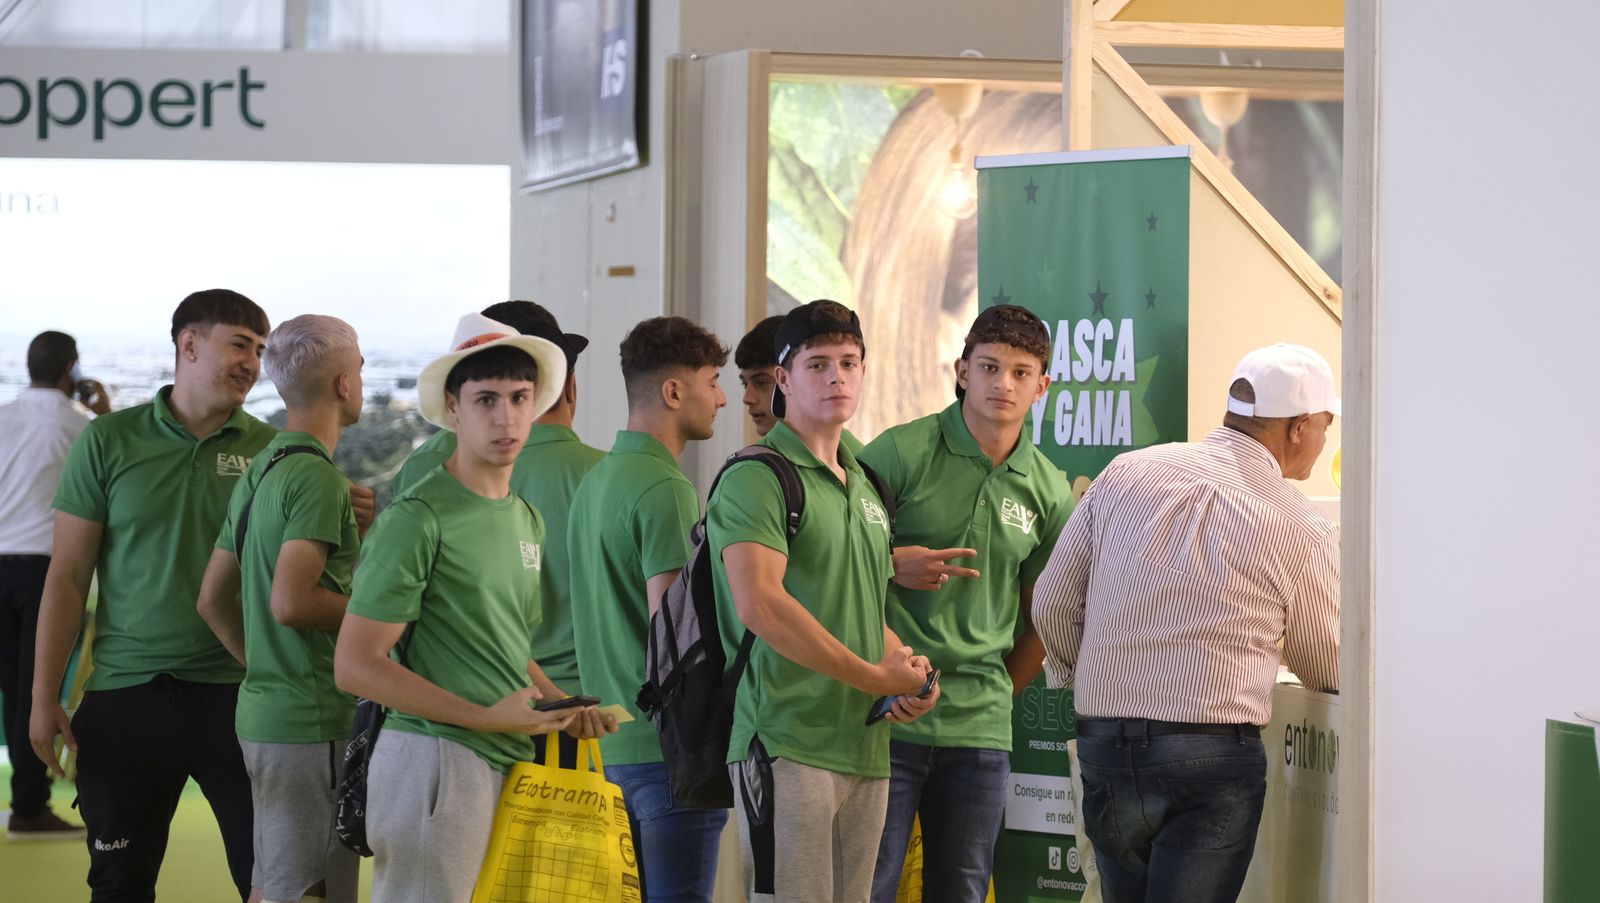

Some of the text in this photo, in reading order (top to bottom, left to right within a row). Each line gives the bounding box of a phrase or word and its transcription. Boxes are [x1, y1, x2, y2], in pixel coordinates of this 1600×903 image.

[1044, 318, 1136, 382] ASCA
[1054, 390, 1132, 446] GANA
[1029, 740, 1055, 751] PREMIOS
[1014, 783, 1052, 801] Consigue
[1054, 789, 1065, 800] un
[1046, 812, 1055, 823] en
